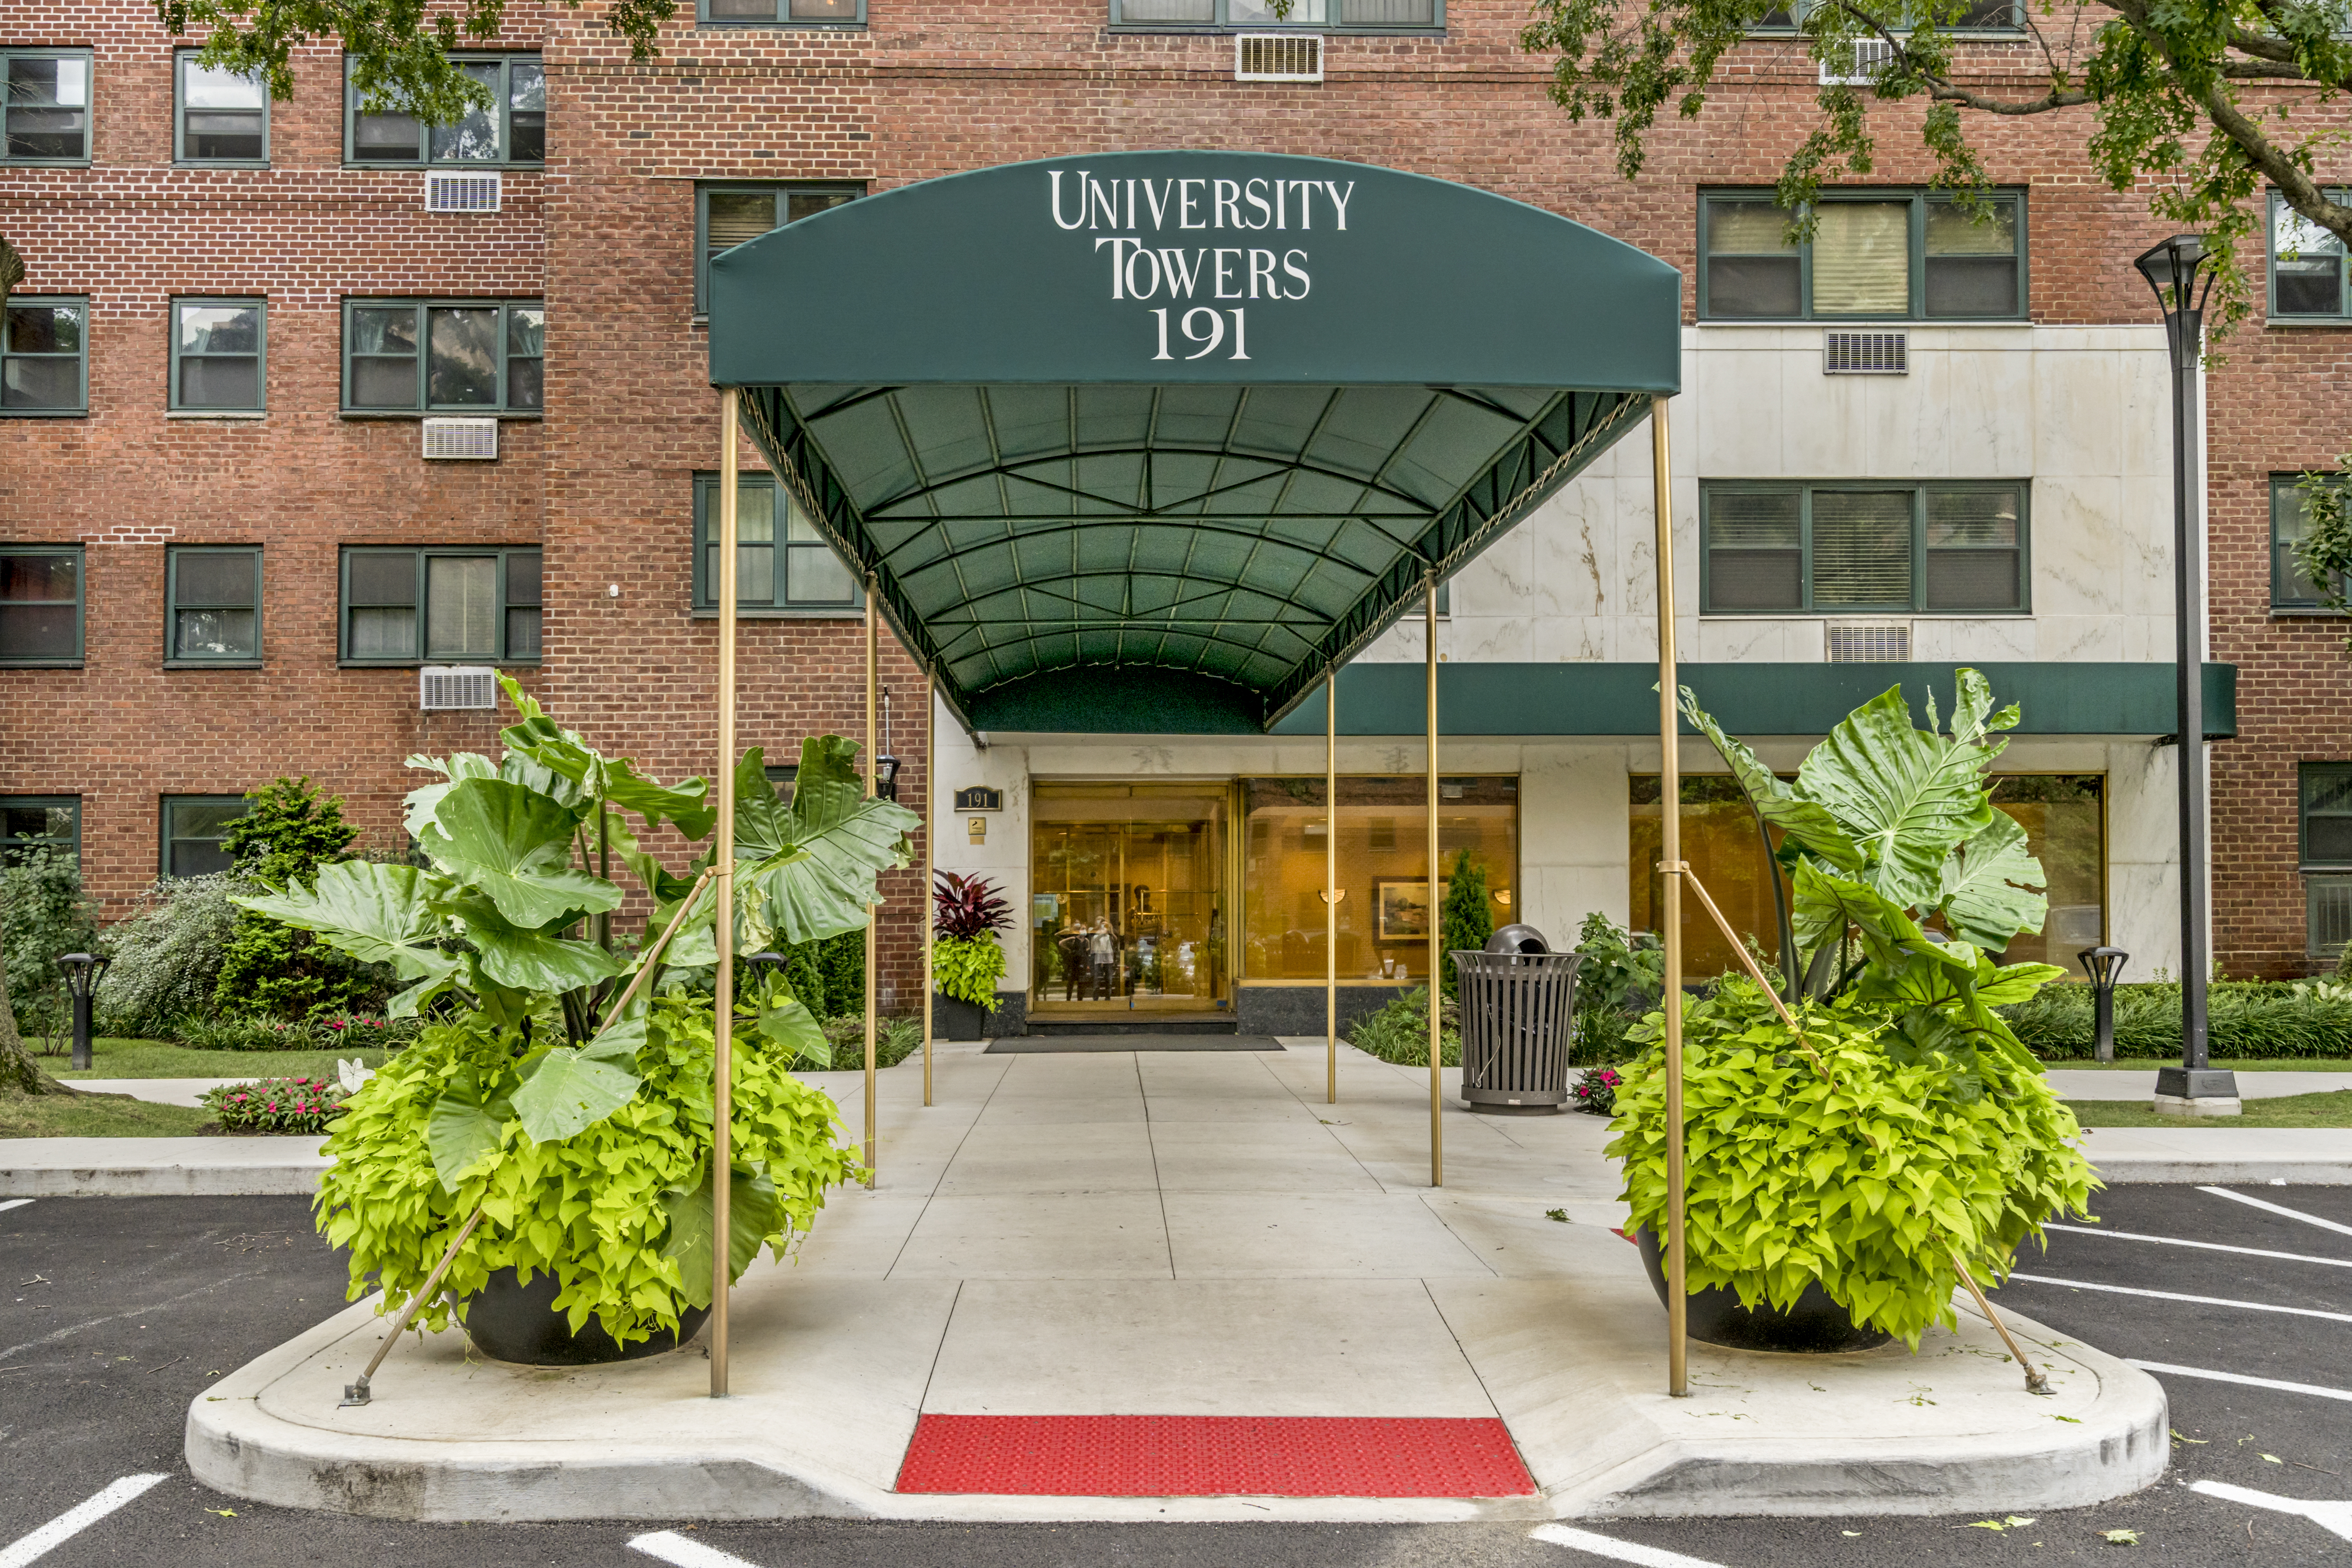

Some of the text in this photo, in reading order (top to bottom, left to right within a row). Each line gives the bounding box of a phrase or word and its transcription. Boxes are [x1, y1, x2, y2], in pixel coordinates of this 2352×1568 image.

[1048, 171, 1354, 230] UNIVERSITY
[1096, 238, 1310, 299] TOWERS
[1148, 307, 1251, 359] 191
[968, 793, 987, 807] 191
